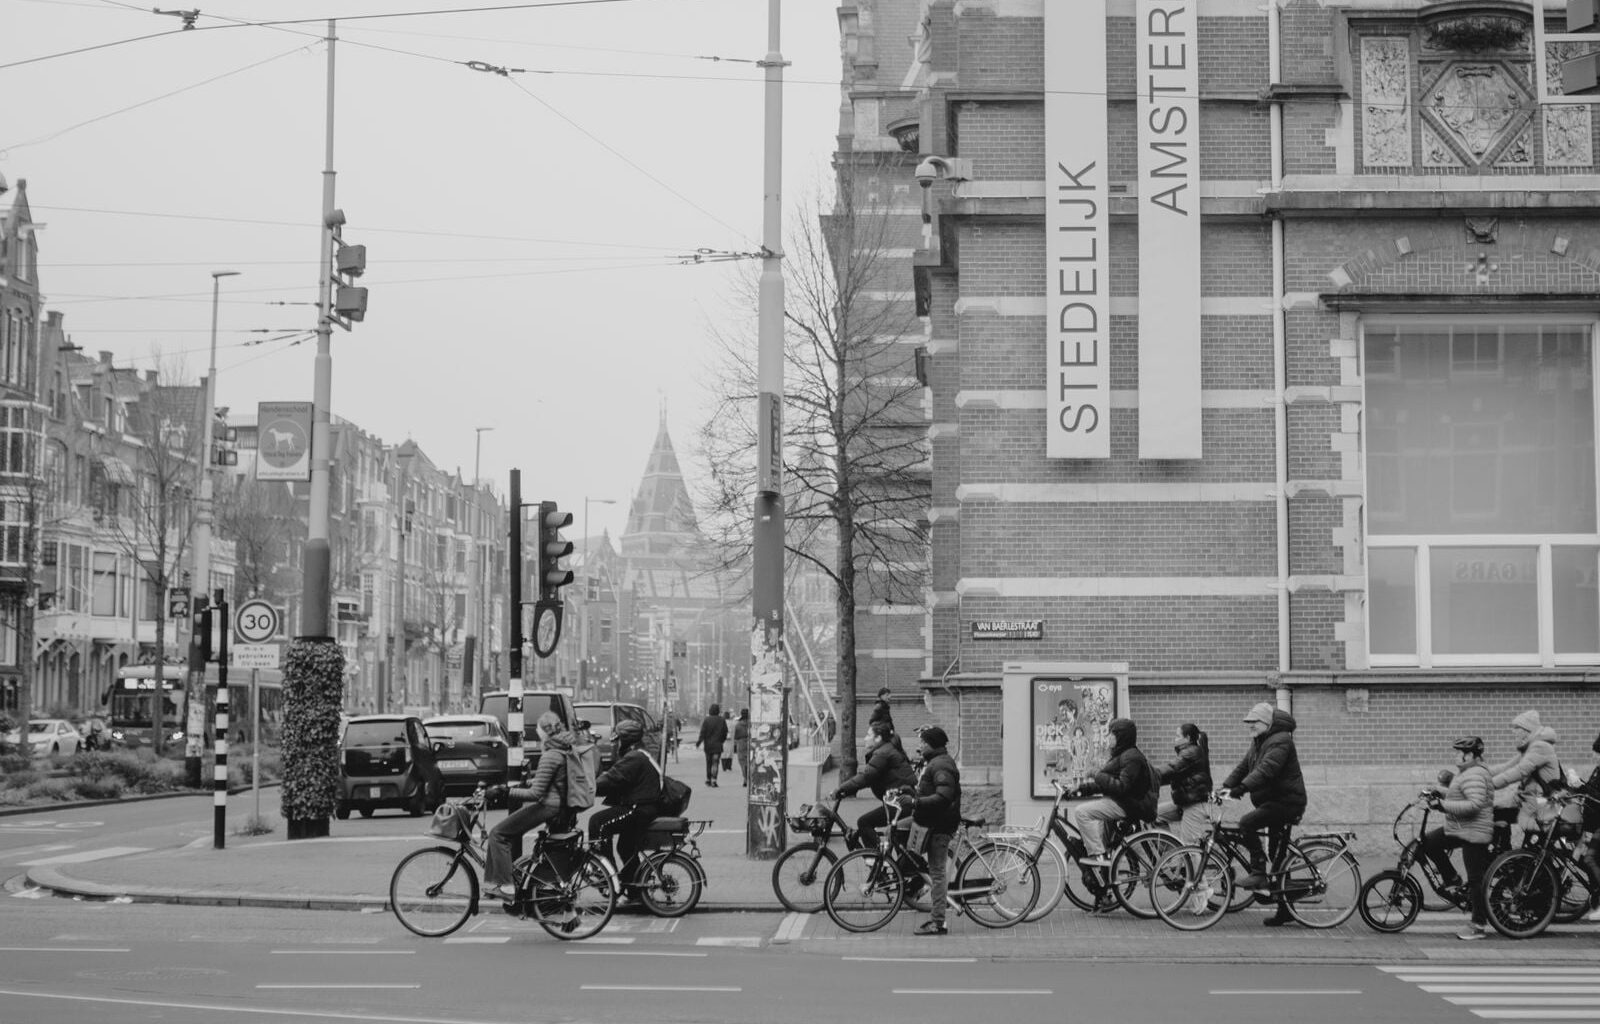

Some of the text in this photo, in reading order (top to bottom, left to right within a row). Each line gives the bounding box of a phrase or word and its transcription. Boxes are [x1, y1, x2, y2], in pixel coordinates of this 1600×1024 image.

[1149, 6, 1188, 216] AMSTER
[1058, 160, 1099, 435] STEDELIJK
[245, 614, 270, 630] 30
[976, 622, 1038, 631] VAN BAERLESTRAAT
[1035, 725, 1064, 736] DICK
[1035, 735, 1070, 745] MAAS
